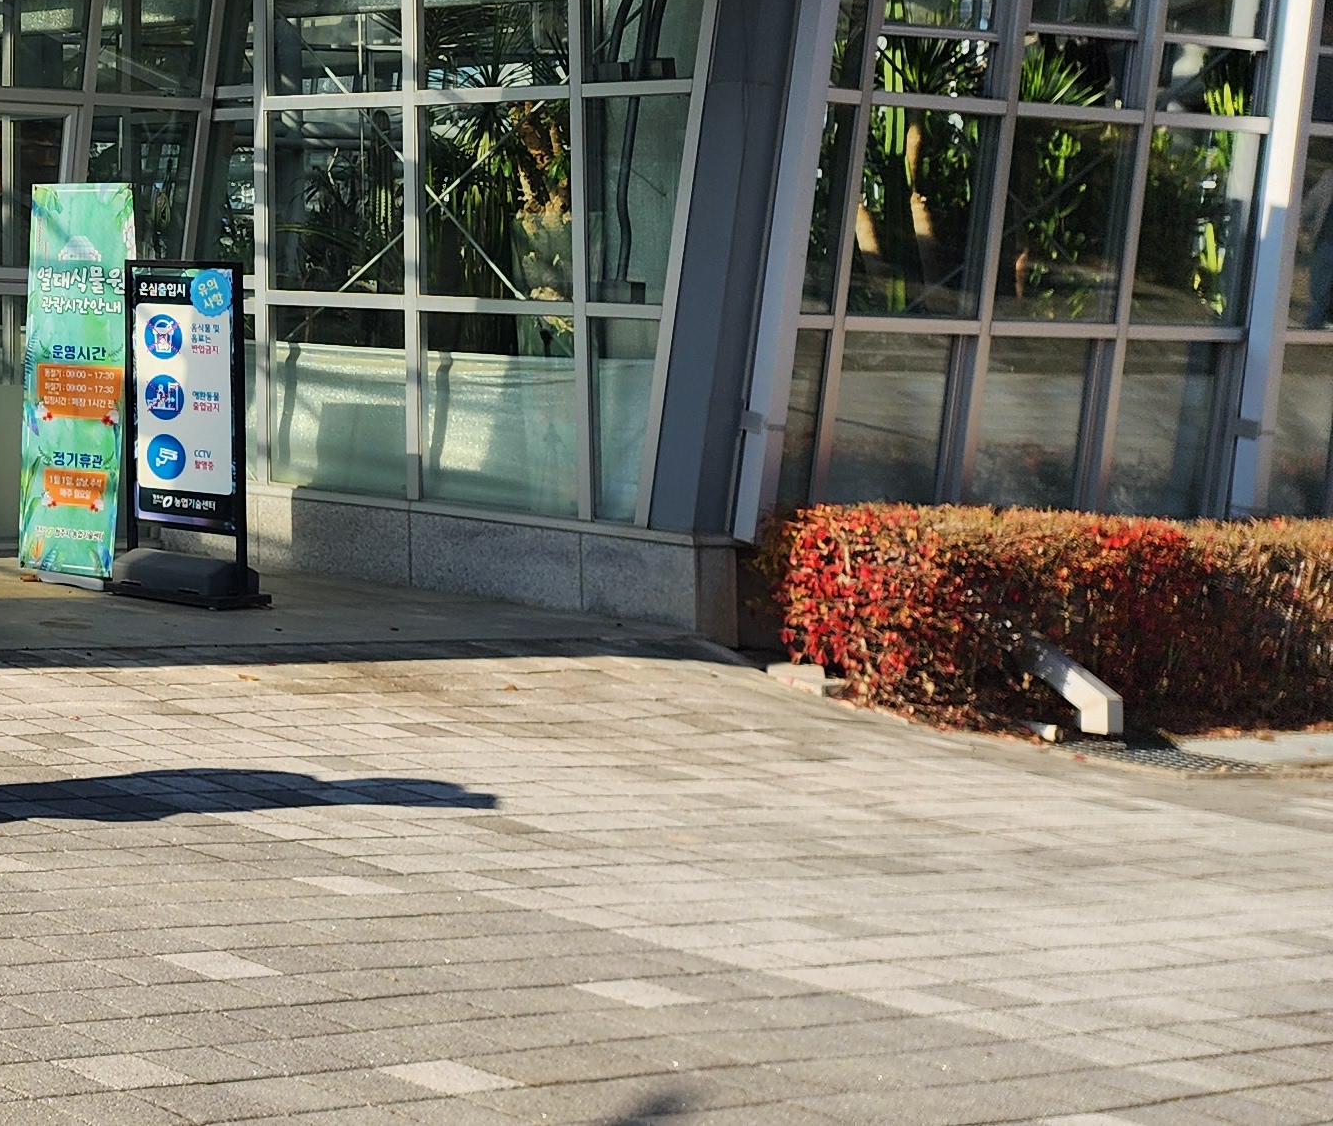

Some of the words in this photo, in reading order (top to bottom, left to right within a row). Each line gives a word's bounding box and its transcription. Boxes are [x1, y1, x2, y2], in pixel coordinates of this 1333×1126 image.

[37, 266, 125, 294] 열대식물원
[198, 277, 219, 297] 유의
[139, 281, 186, 298] 온실출입시
[41, 295, 122, 315] 관람시간안내
[203, 291, 224, 309] 사항
[52, 344, 107, 362] 운영시간
[192, 345, 220, 355] 반입금지
[193, 401, 220, 413] 출입금지
[52, 451, 103, 469] 정기휴관
[193, 449, 212, 459] CCTV
[174, 496, 217, 512] 농업기술센터
